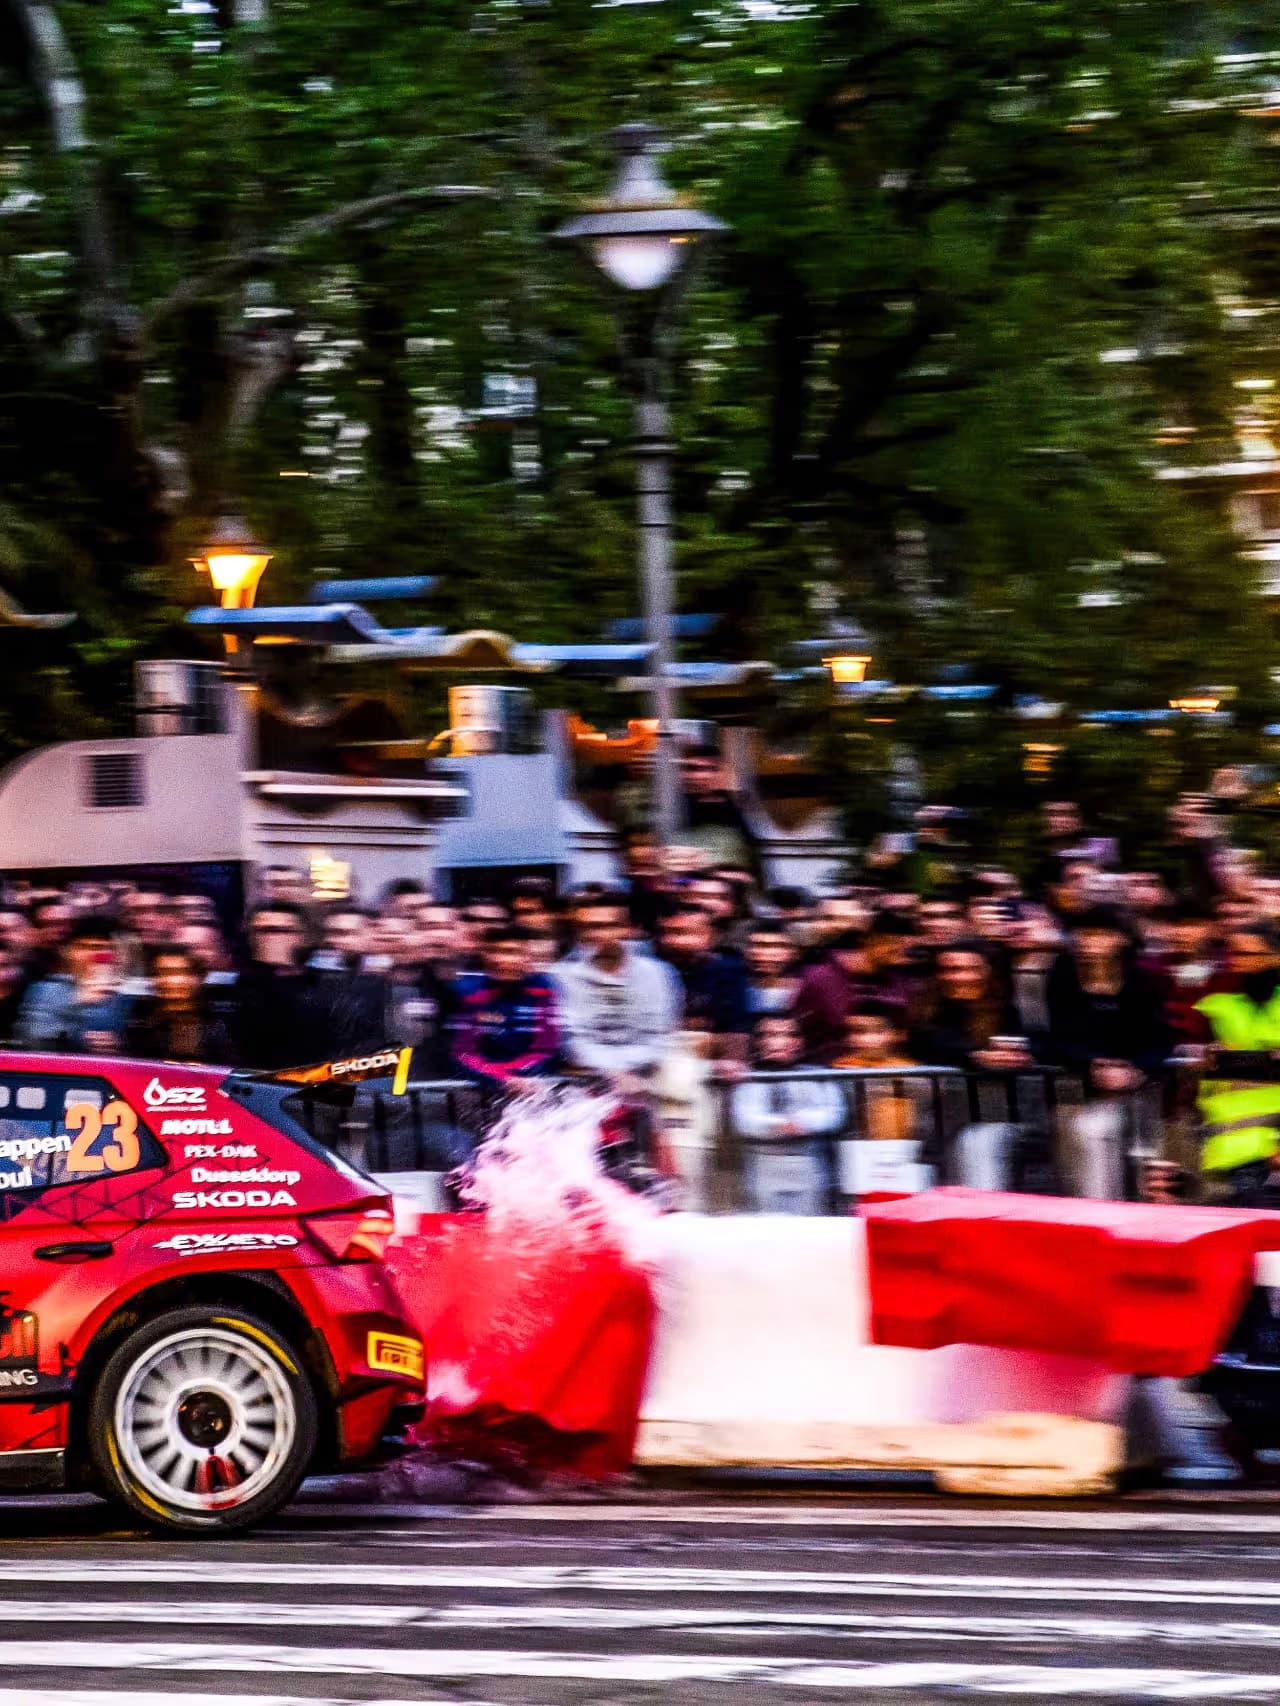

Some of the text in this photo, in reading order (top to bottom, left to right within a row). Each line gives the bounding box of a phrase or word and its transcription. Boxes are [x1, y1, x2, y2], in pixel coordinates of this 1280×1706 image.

[331, 1053, 400, 1075] SKODA
[65, 1101, 140, 1172] 23
[190, 1166, 301, 1186] Dusseldorp
[172, 1190, 297, 1208] SKODA
